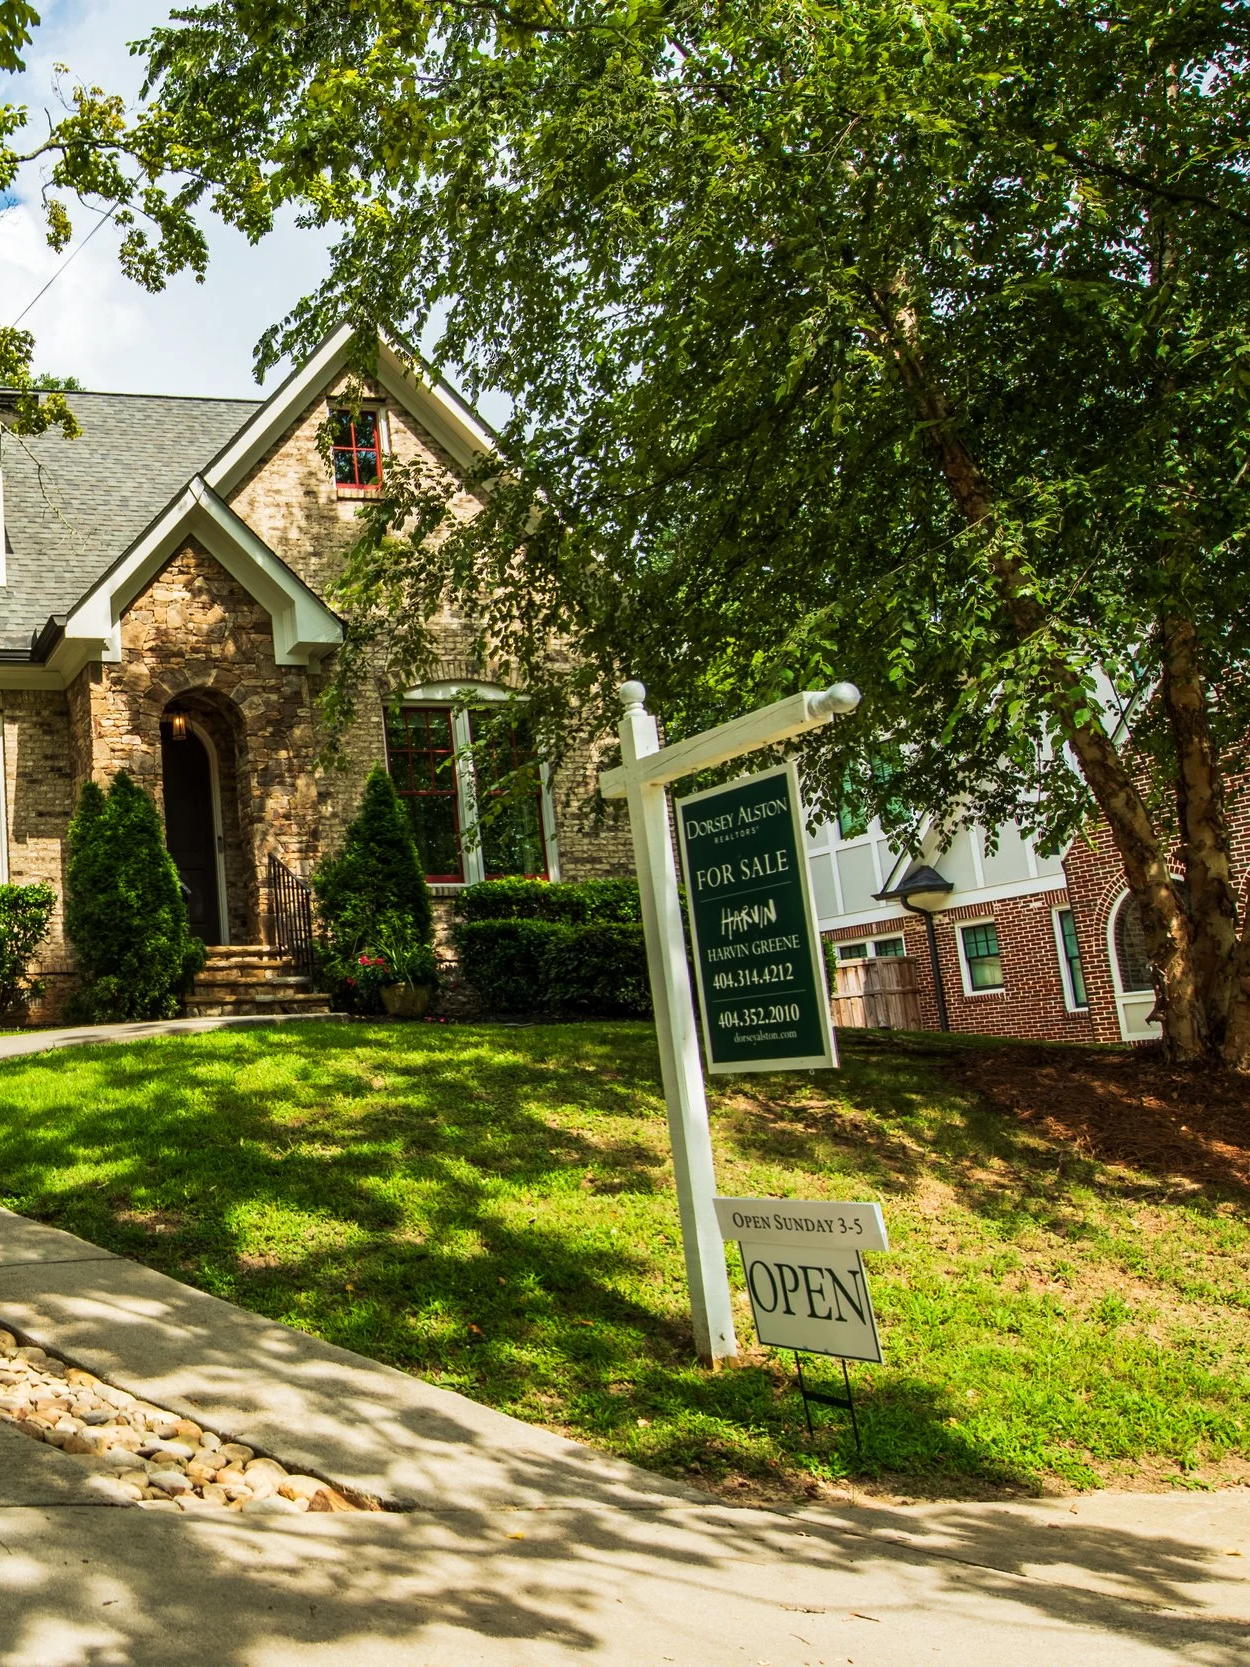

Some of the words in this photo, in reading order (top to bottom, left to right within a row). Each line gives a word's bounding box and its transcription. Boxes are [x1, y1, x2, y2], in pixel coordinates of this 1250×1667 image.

[686, 813, 734, 840] DORSEY
[738, 797, 788, 826] ALSTON
[696, 864, 735, 891] FOR
[740, 849, 789, 880] SALE
[721, 899, 777, 940] HARVIN
[707, 943, 750, 962] HARVIN
[751, 934, 800, 955] GREENE
[713, 963, 794, 990] 404.314.4212
[718, 1003, 800, 1029] 404.352.2010
[734, 1030, 798, 1046] dorseyalston.com
[732, 1211, 771, 1230] OPEN
[773, 1214, 834, 1233] SUNDAY
[837, 1217, 863, 1235] 3-5
[750, 1260, 867, 1326] OPEN
